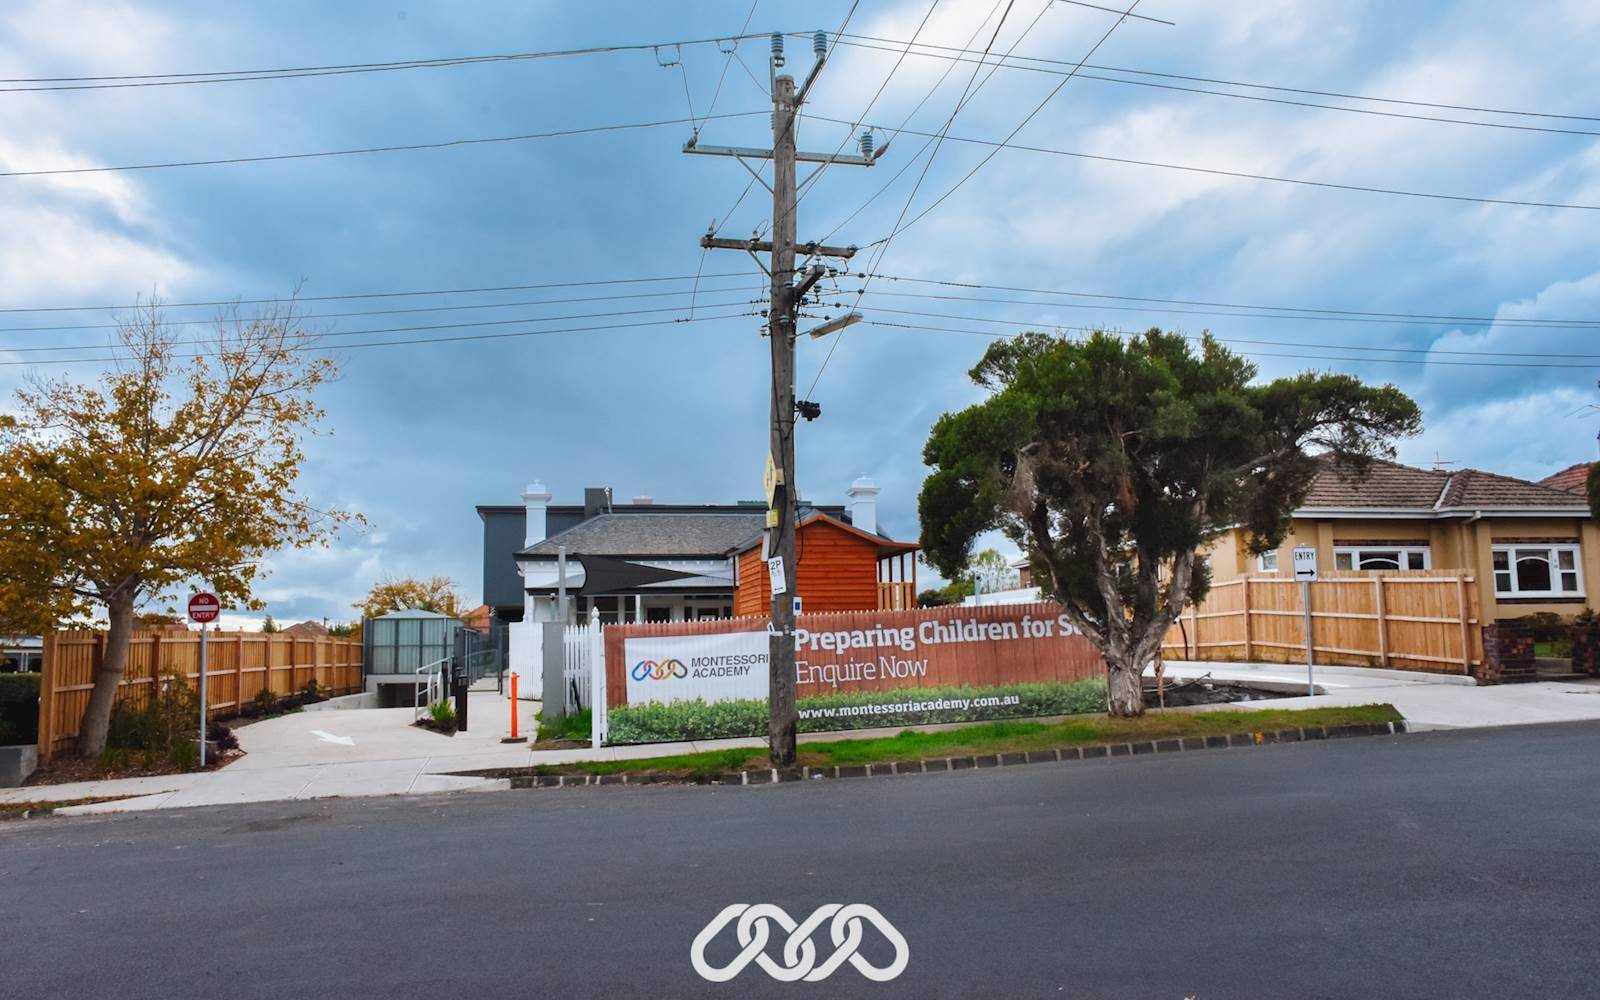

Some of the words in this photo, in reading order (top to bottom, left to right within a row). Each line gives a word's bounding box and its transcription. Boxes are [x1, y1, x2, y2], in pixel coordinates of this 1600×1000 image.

[1294, 551, 1315, 560] ENTRY
[770, 560, 781, 570] 2P
[794, 624, 914, 654] Preparing
[919, 618, 1017, 644] Children
[1021, 615, 1054, 637] for
[690, 653, 769, 668] MONTESSORI
[692, 665, 751, 679] ACADEMY
[795, 660, 876, 688] Enquire
[879, 656, 928, 679] Now
[798, 694, 1019, 719] www.montessoriacademy.com.au
